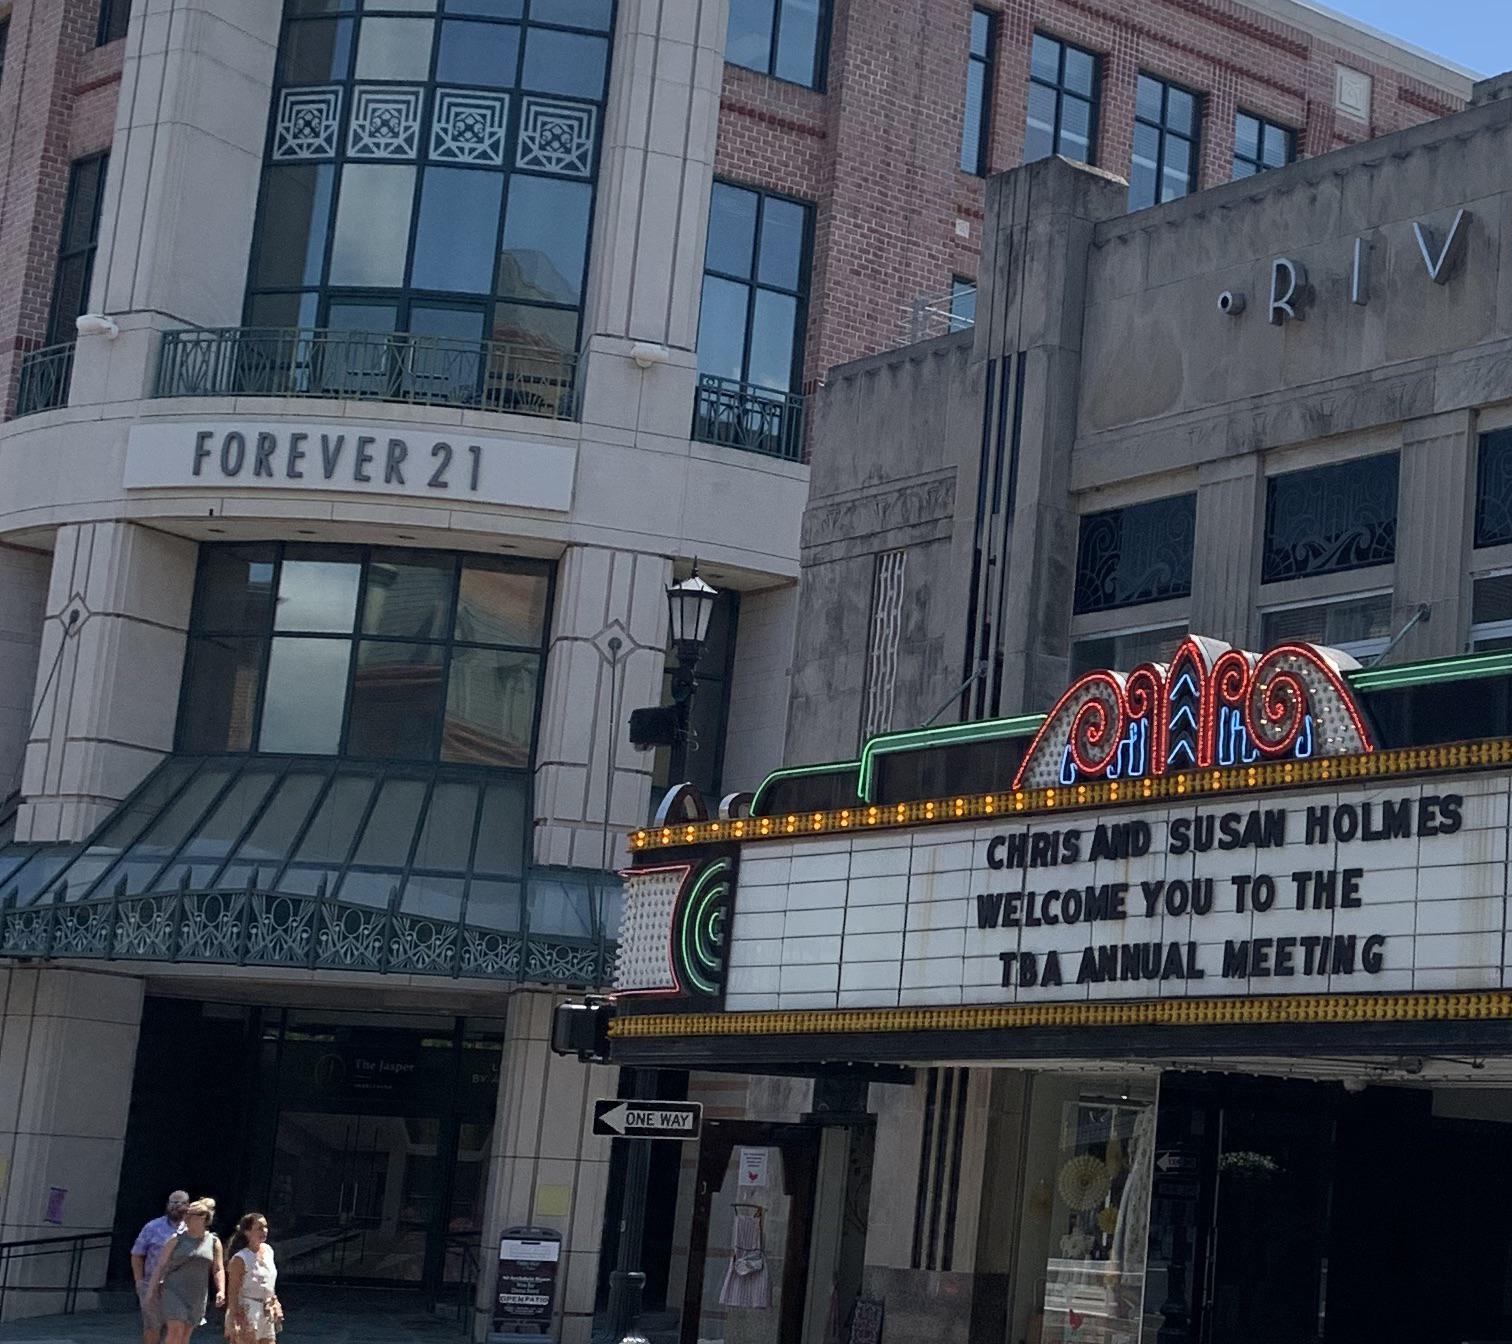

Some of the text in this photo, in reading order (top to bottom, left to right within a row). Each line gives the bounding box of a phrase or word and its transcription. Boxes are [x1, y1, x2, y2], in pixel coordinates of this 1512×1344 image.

[192, 430, 482, 492] FOREVER 21
[986, 794, 1465, 870] CHRIS AND SUSAN HOLMES
[976, 868, 1364, 929] WELCOME YOU TO THE
[999, 934, 1386, 988] TBA ANNUAL MEETING
[354, 1058, 376, 1070] The
[626, 1112, 689, 1127] ONE WAY
